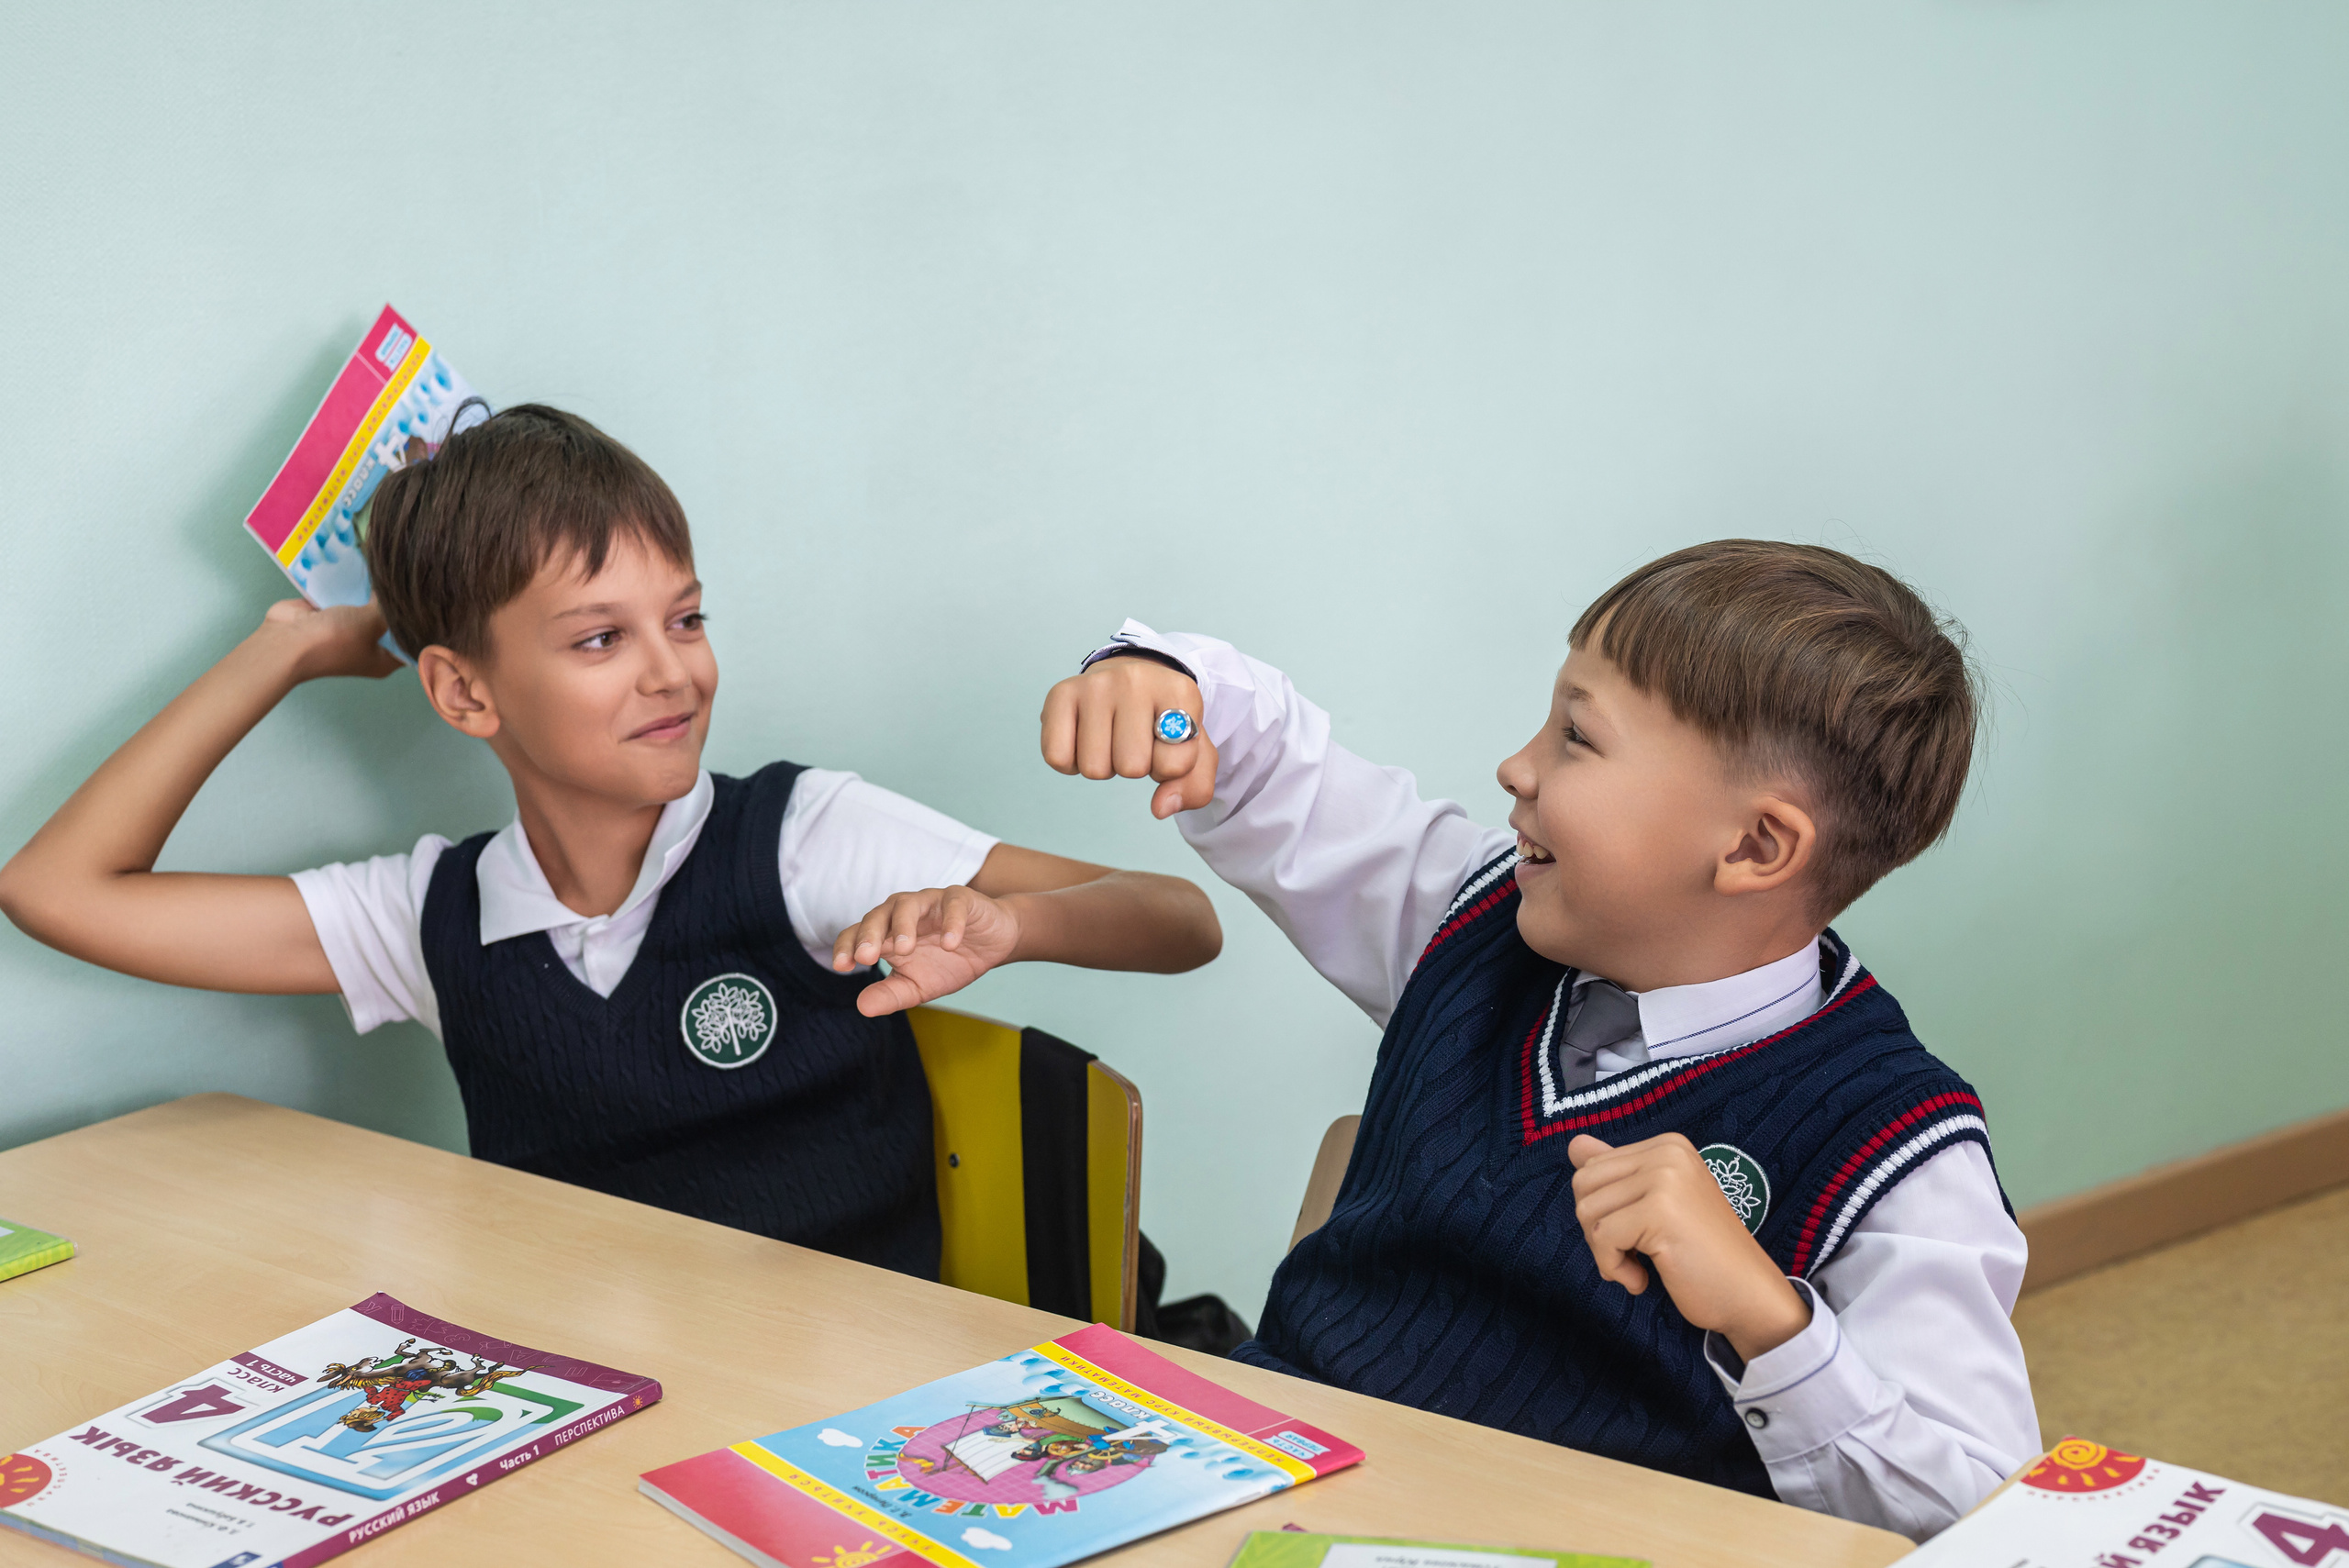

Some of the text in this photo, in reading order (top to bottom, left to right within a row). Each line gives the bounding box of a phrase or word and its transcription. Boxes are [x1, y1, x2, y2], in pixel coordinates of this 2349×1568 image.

[374, 431, 407, 473] 4
[227, 1367, 285, 1394] класс
[246, 1359, 297, 1383] часть 1
[141, 1384, 246, 1424] 4
[1060, 1355, 1286, 1463] НЕПРЕРЫВНЫЙ КУРС МАТЕМАТИКИ
[1089, 1391, 1177, 1440] 4 класс
[68, 1426, 356, 1527] РУССКИЙ ЯЗЫК
[348, 1506, 406, 1543] РУССКИЙ
[406, 1491, 440, 1516] ЯЗЫК
[499, 1451, 532, 1471] Часть
[532, 1445, 540, 1455] 1
[554, 1405, 625, 1446] ПЕРСПЕКТИВА
[864, 1425, 1079, 1518] МАТЕМАТИКА
[2127, 1481, 2227, 1554] ЯЗЫК
[2253, 1512, 2349, 1567] 4
